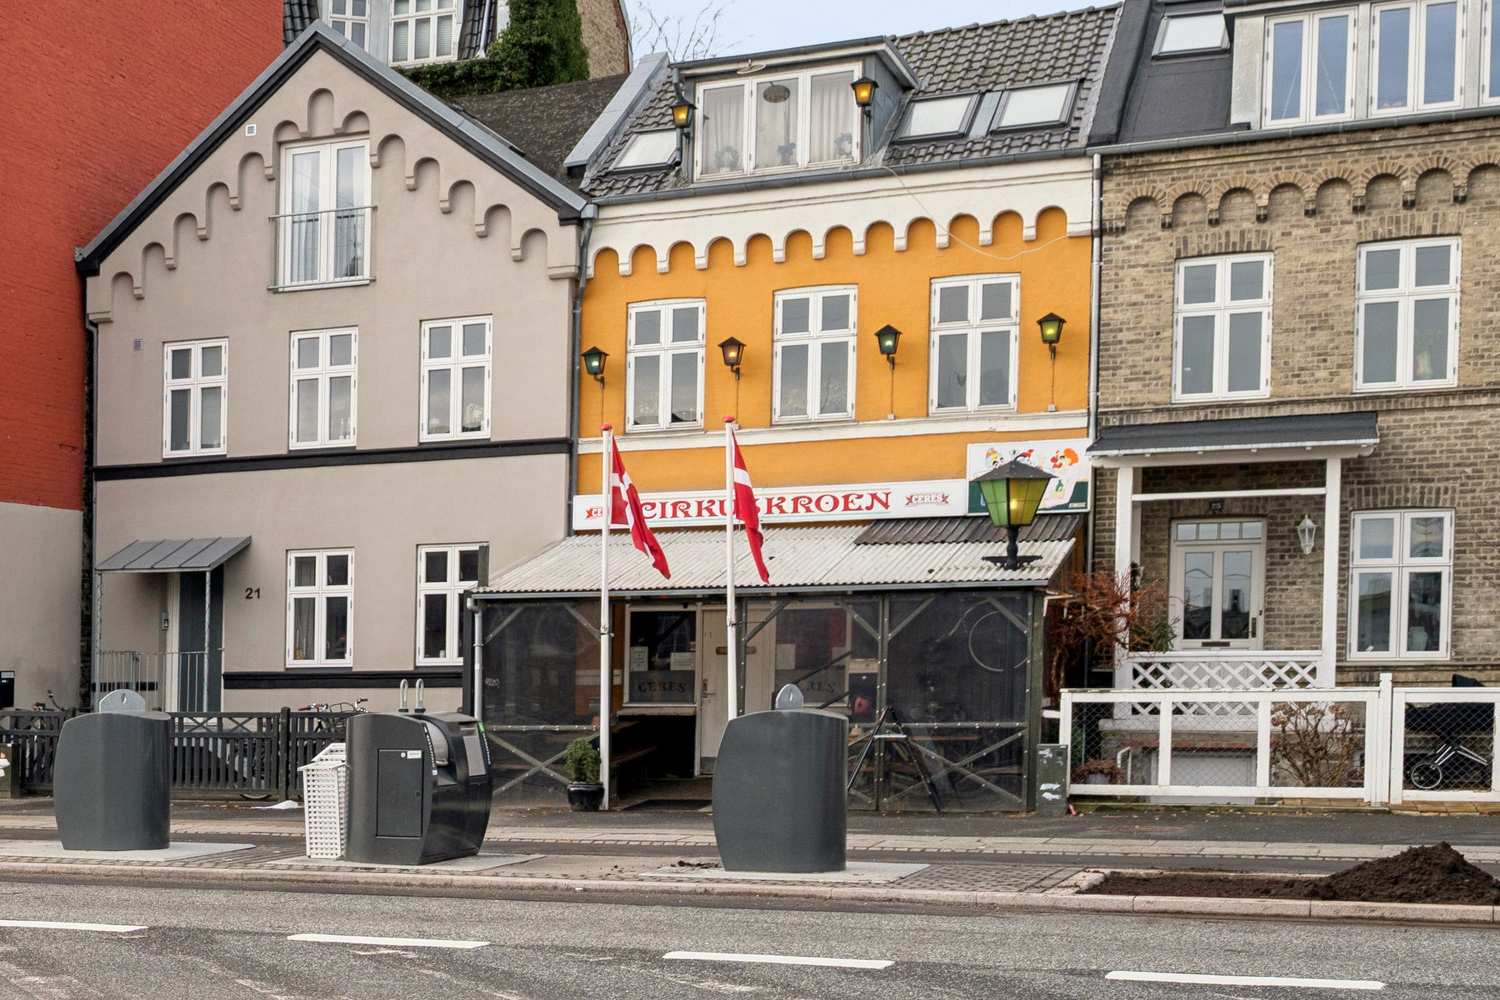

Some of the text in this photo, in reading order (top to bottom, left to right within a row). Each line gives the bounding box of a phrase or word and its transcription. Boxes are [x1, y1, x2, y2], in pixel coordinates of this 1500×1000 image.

[639, 491, 892, 519] CIRKUKROEN
[912, 494, 941, 504] CERES
[245, 587, 260, 599] 21
[638, 680, 686, 693] CERES
